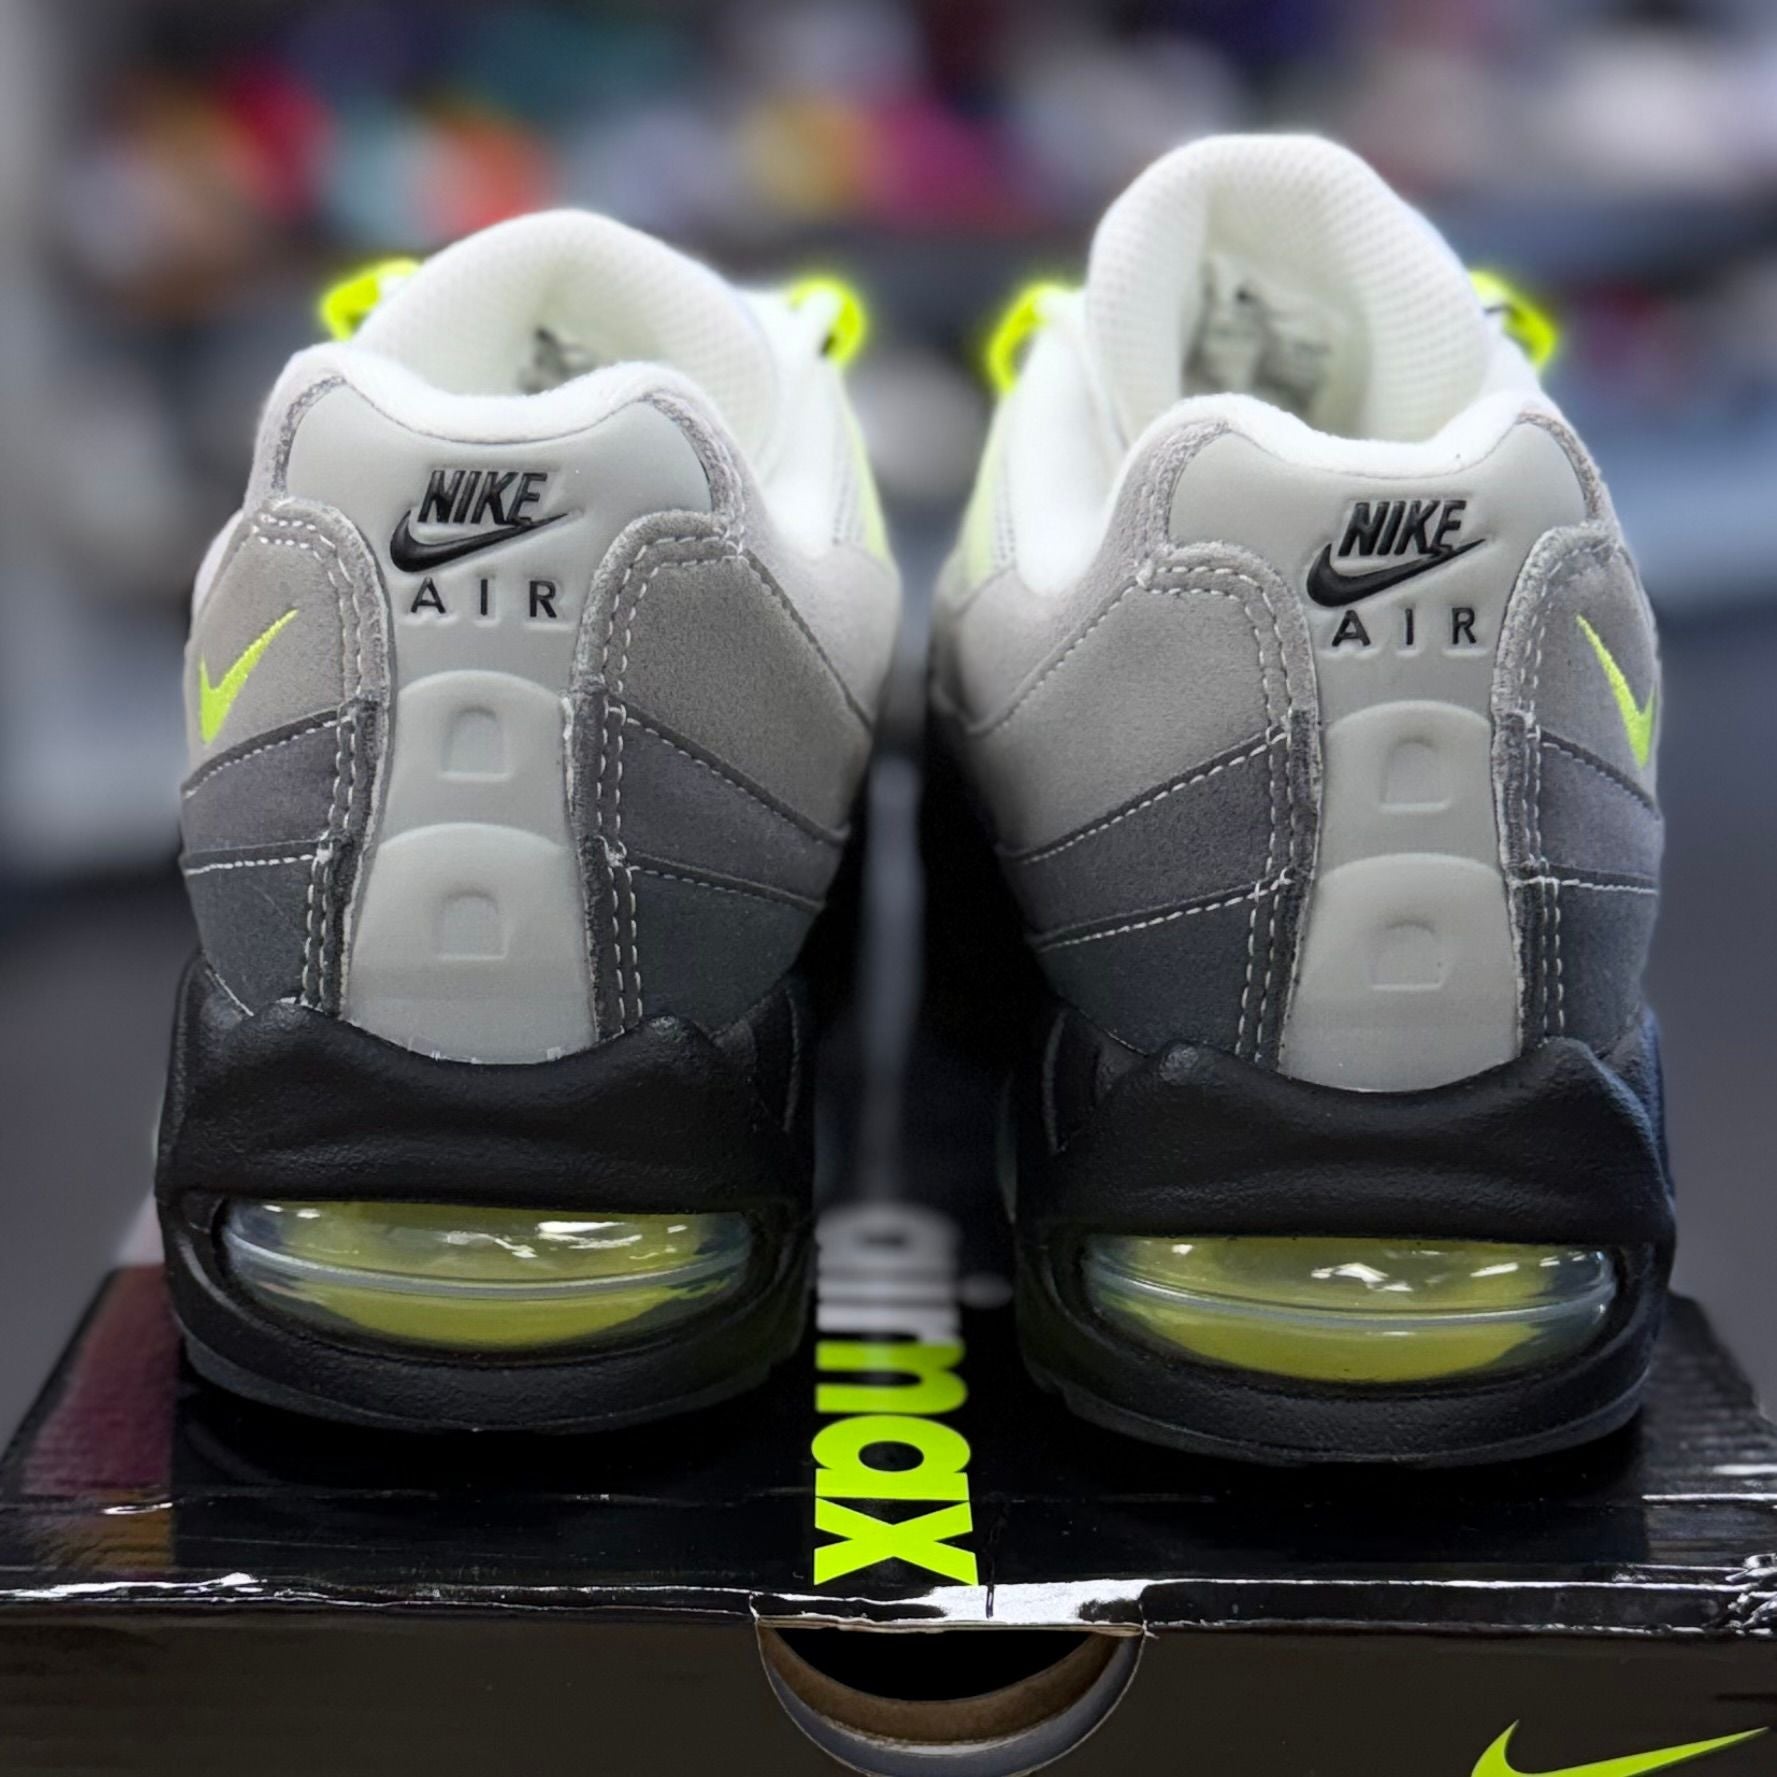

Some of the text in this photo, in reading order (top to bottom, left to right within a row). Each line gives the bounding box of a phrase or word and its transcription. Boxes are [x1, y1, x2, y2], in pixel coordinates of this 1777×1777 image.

[417, 470, 548, 526] NIKE
[1338, 500, 1467, 556] NIKE
[411, 577, 557, 618] AIR
[1332, 607, 1476, 647] AIR
